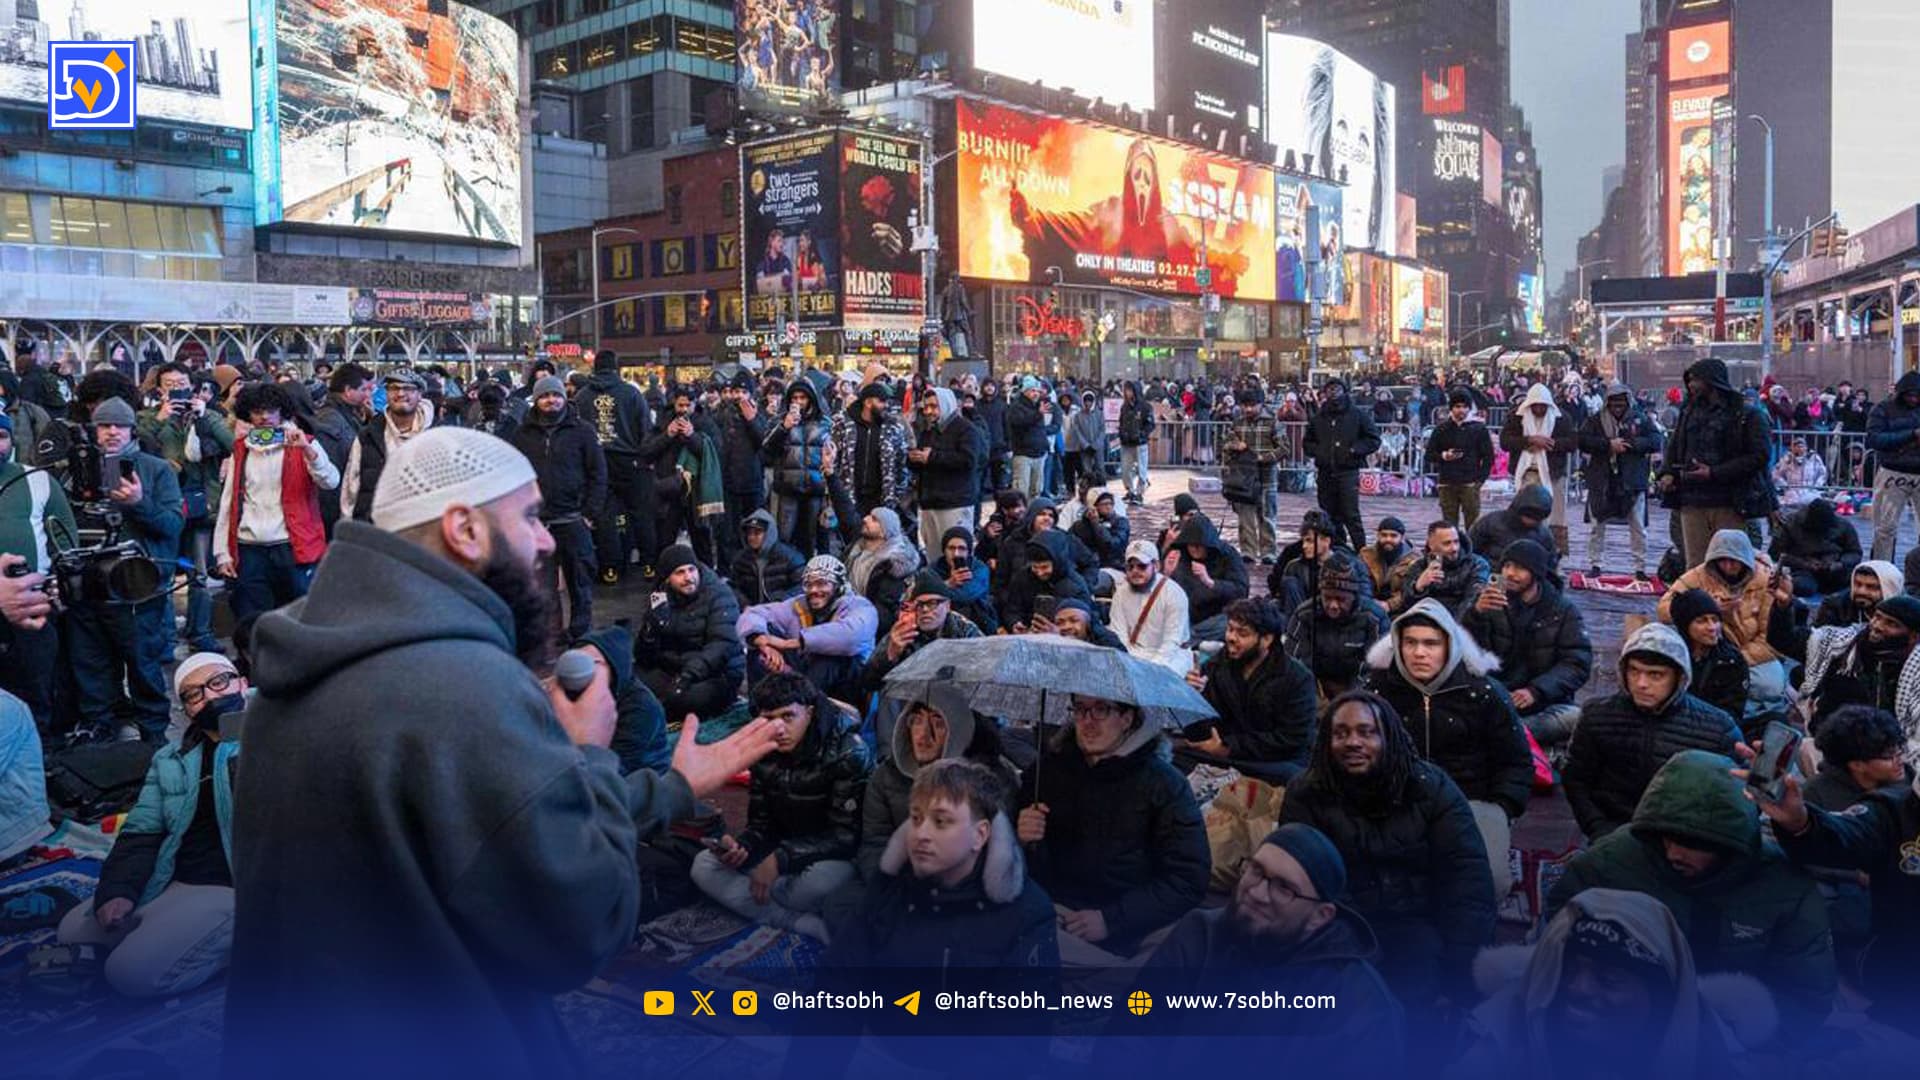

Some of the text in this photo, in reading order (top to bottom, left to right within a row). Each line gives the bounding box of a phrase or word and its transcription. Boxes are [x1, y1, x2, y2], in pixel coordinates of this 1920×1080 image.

[769, 173, 791, 191] two
[764, 182, 820, 203] strangers
[1076, 252, 1102, 268] ONLY
[725, 334, 757, 347] GIFTS
